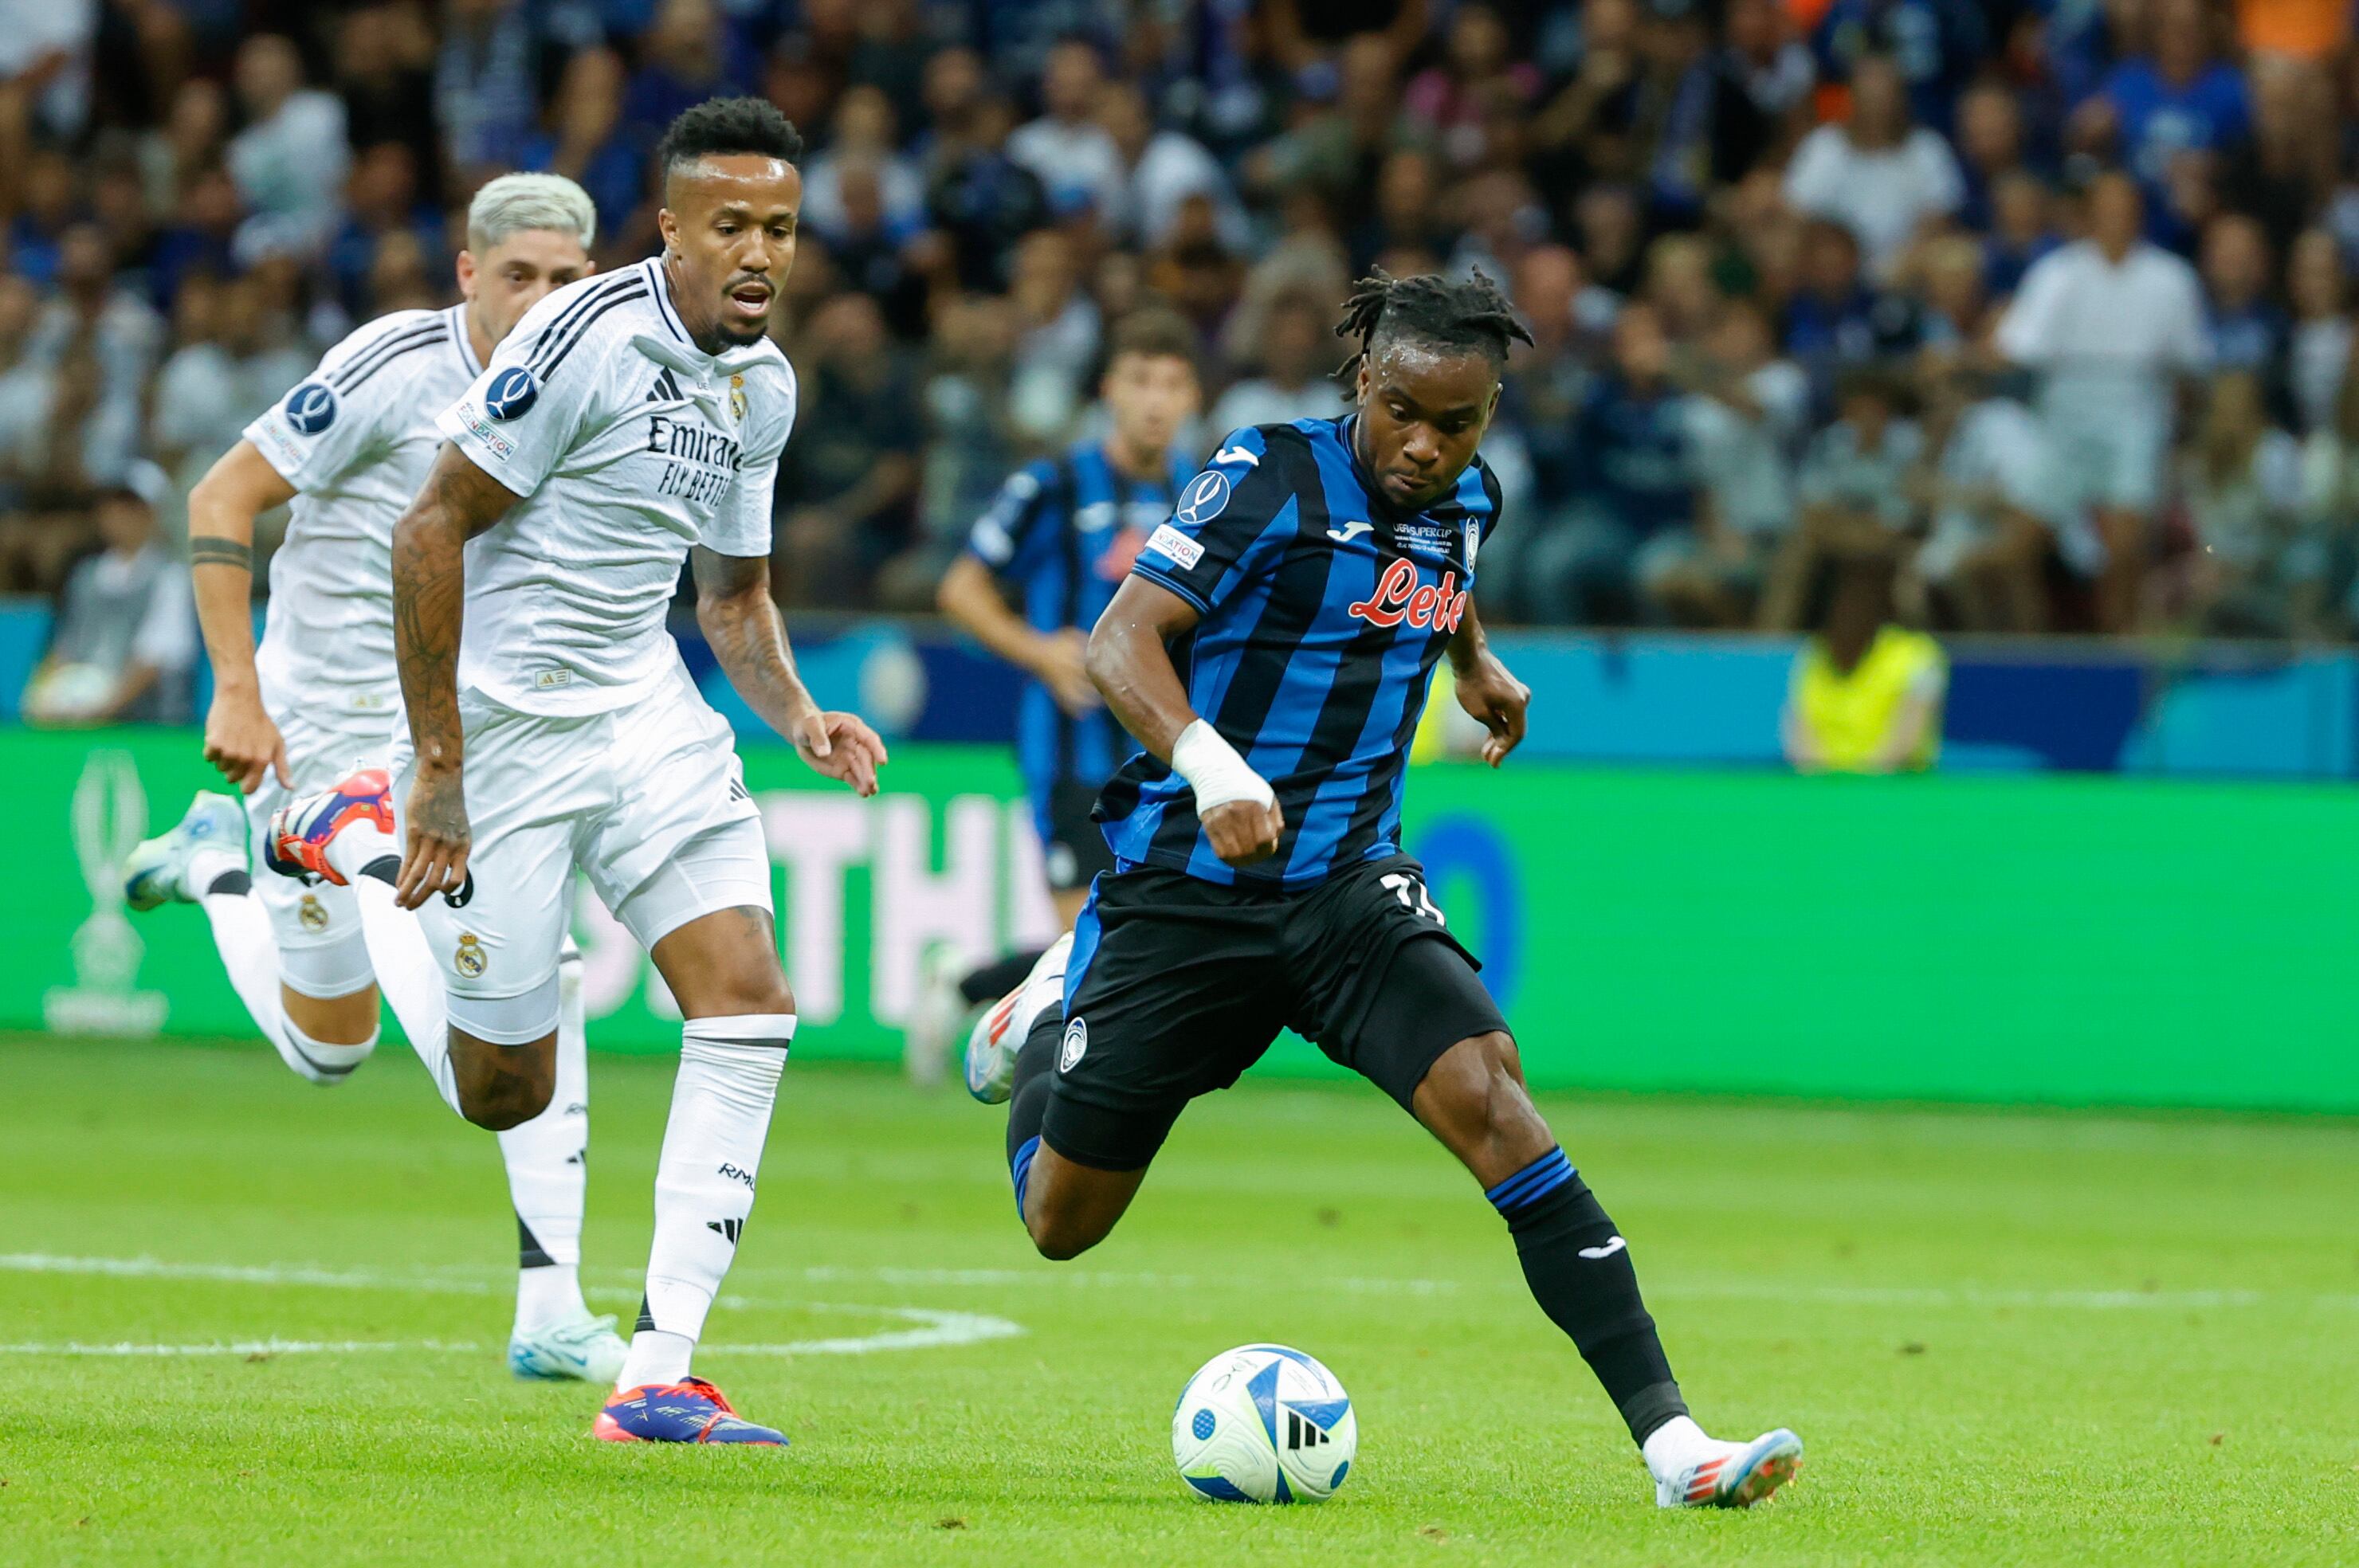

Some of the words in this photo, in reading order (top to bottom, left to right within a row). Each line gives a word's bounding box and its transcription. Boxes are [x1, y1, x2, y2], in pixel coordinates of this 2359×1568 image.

[657, 462, 689, 496] FLY
[1435, 528, 1453, 539] CUP
[1348, 557, 1466, 634] Lete
